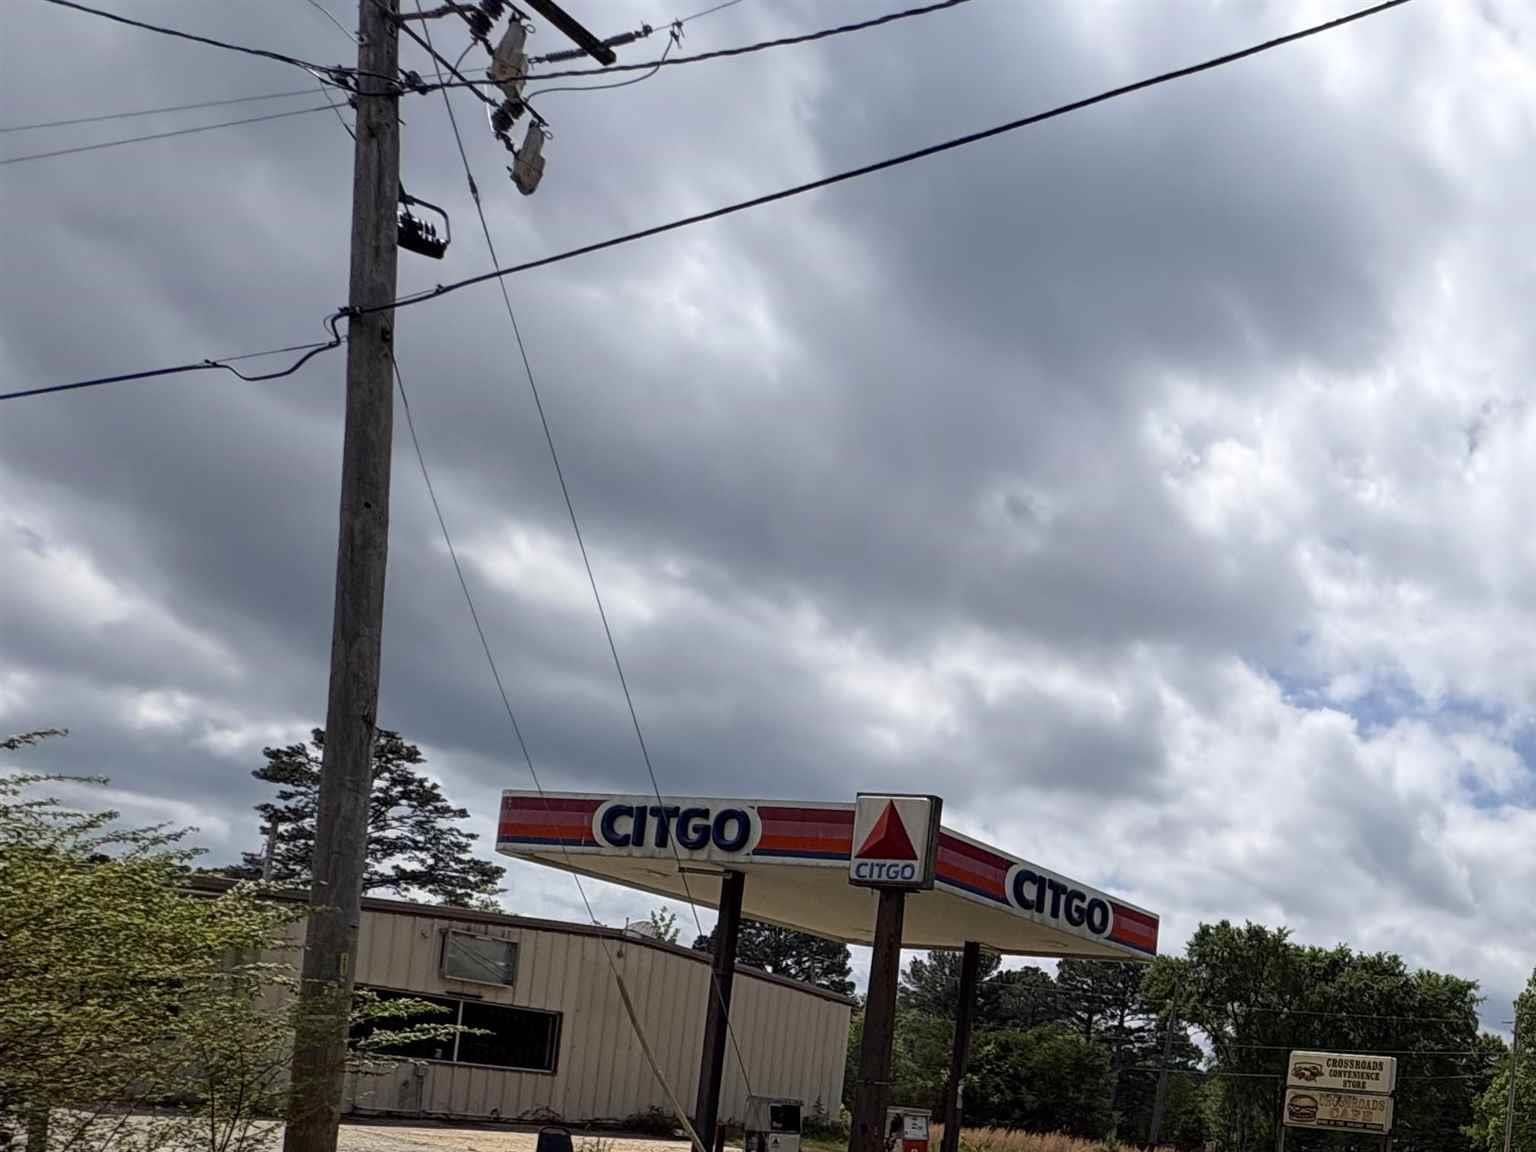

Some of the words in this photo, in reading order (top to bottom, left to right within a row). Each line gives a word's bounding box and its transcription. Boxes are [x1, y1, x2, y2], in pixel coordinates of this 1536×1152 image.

[600, 804, 752, 853] CITGO
[855, 861, 915, 881] CITGO
[1011, 869, 1111, 937] CITGO
[1326, 1058, 1385, 1071] CROSSROADS
[1328, 1069, 1381, 1081] CONVENIENCE
[1342, 1080, 1367, 1089] STORE
